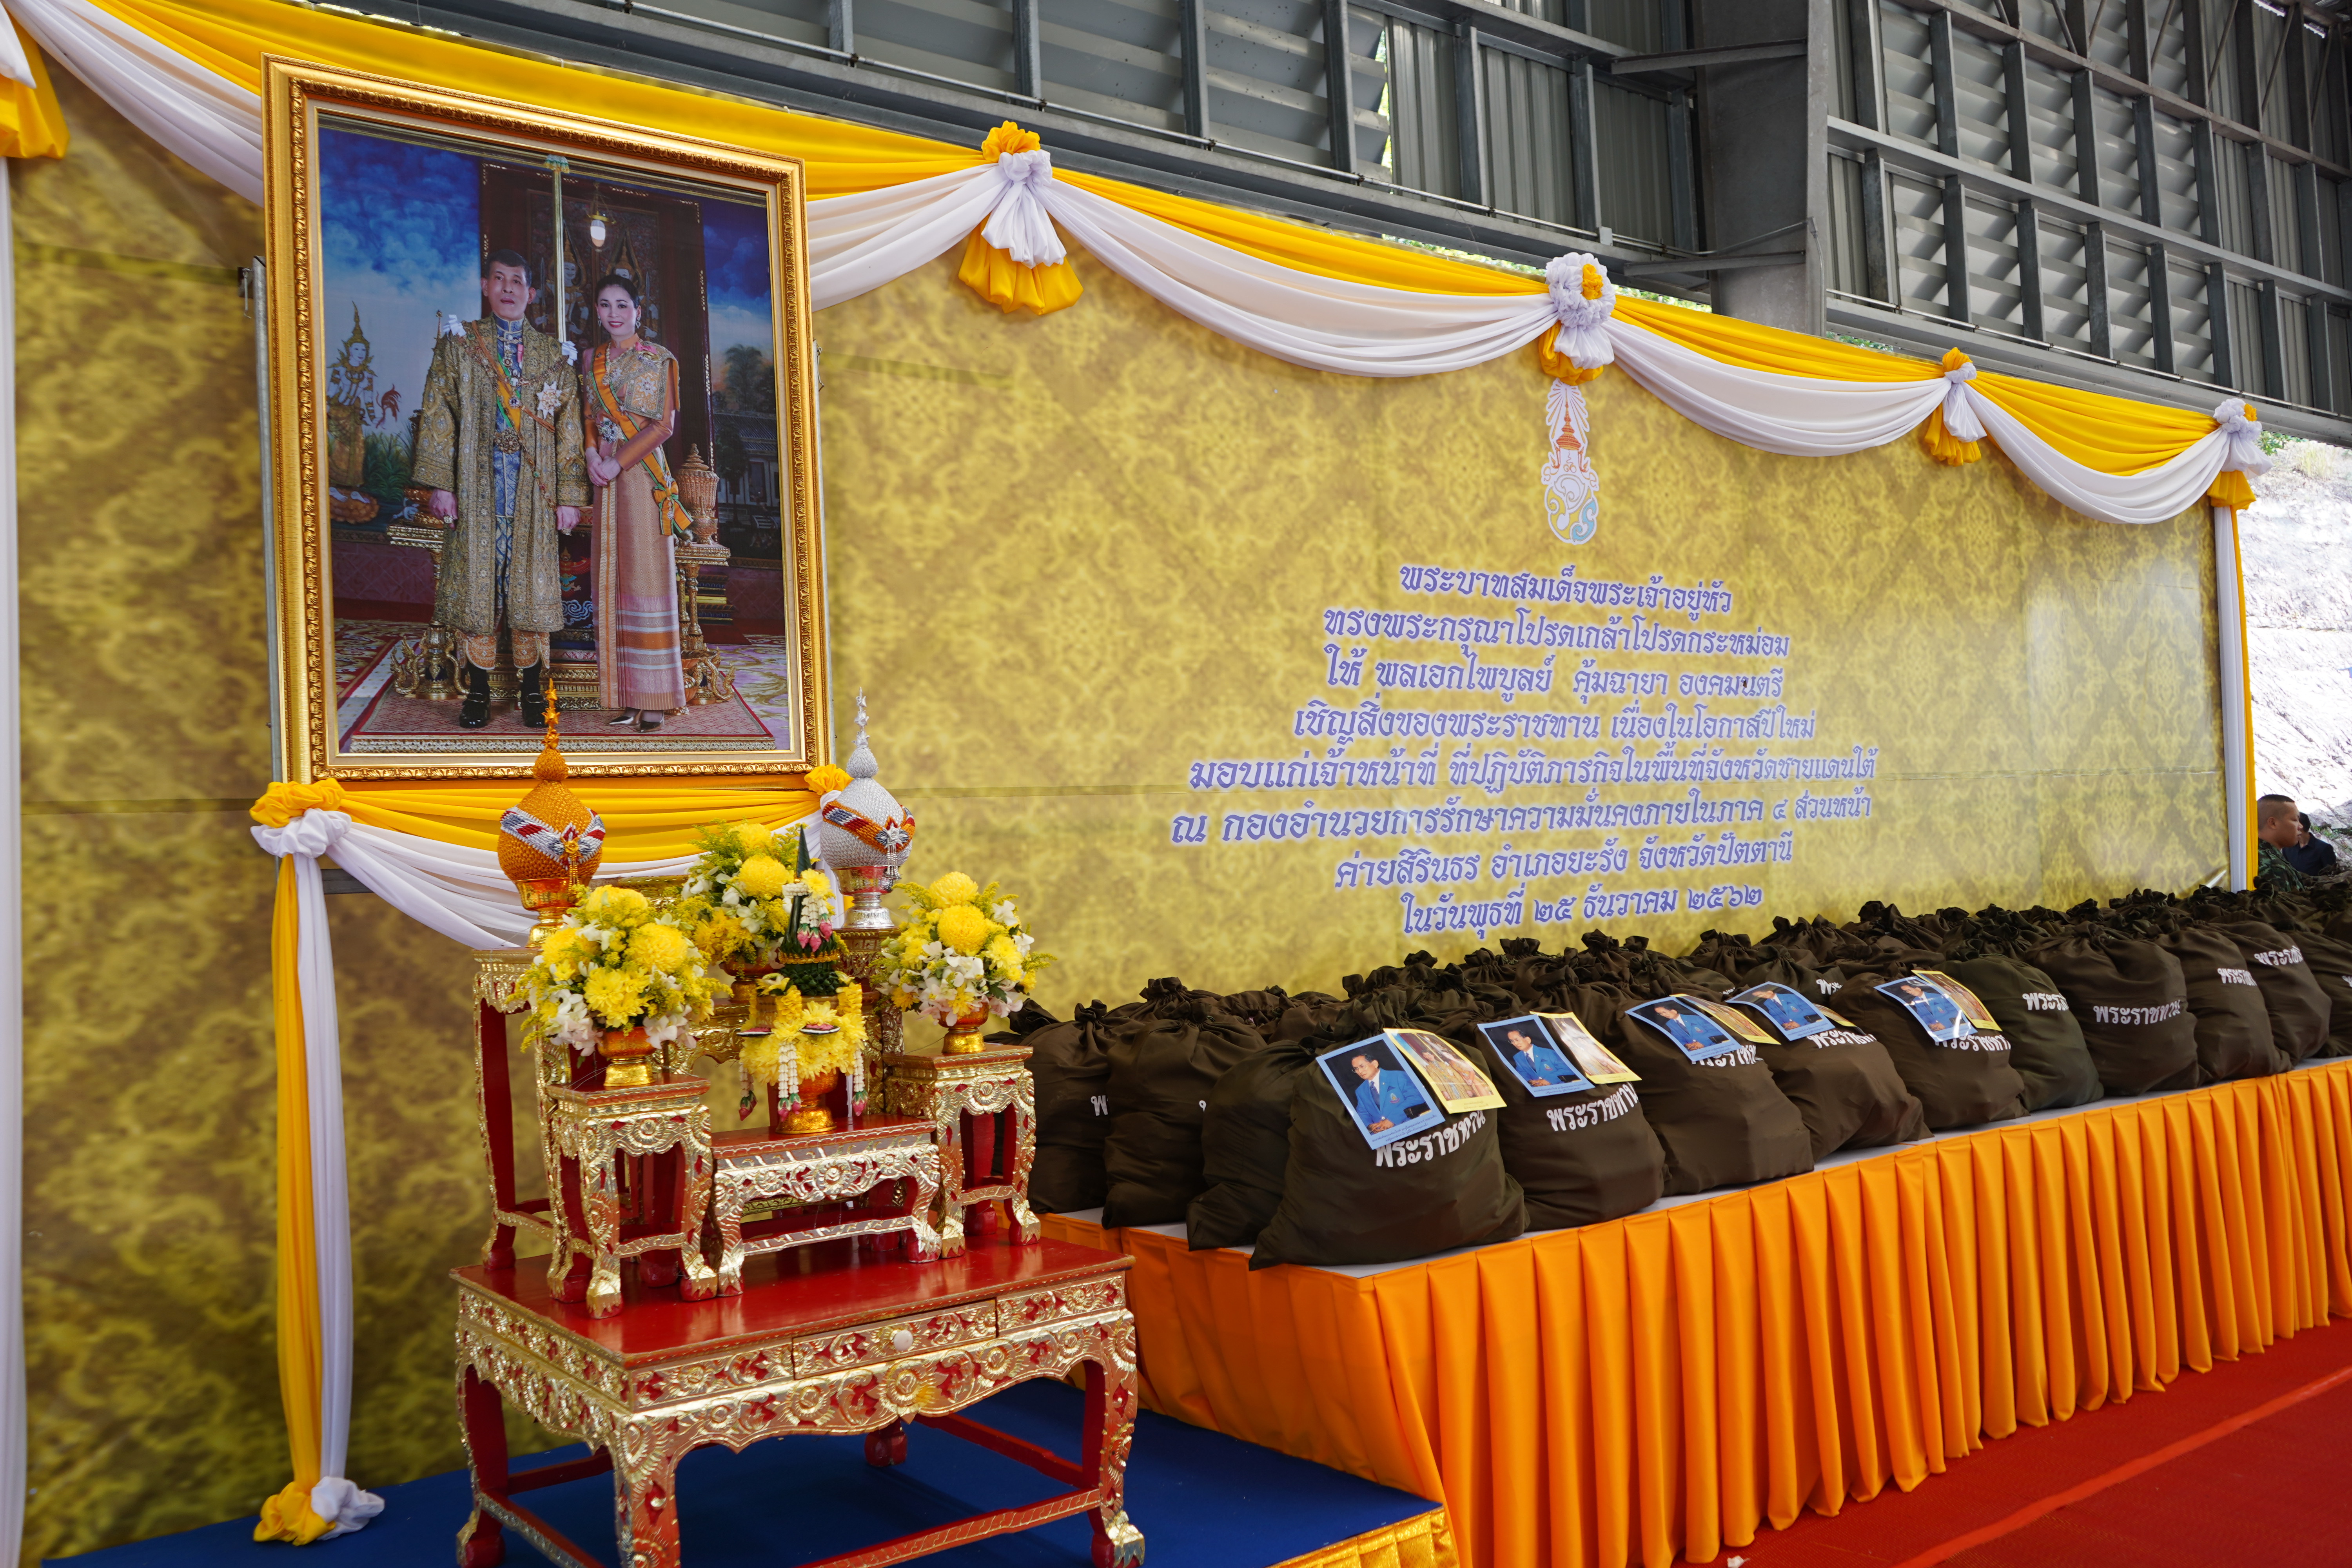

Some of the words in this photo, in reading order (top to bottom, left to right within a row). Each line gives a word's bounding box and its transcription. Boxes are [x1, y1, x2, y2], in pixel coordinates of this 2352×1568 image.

[1399, 565, 1732, 621] พระบาทสมเด็จพระเจ้าอยู่หัว
[1323, 607, 1790, 657] ทรงพระกรุณาโปรดเกล้าโปรดกระหม่อม
[1323, 643, 1368, 686] ให้
[1375, 652, 1556, 702] พลเอกไพบูลย์
[1573, 659, 1669, 704] คุ้มฉายา
[1679, 668, 1784, 697] องคมนตรี
[1294, 692, 1600, 745] เชิญสิ่งของพระราชทาน
[1611, 699, 1815, 739] เนื่องในโอกาสปีใหม่
[1189, 742, 1439, 789] มอบแก่เจ้าหน้าที่
[1449, 741, 1879, 794] ที่ปฏิบัติภารกิจในพื้นที่จังหวัดชายแดนใต้
[1171, 815, 1208, 843] ณ
[1221, 788, 1764, 841] กองอำนวยการรักษาความมั่นคงภายในภาค
[1773, 799, 1789, 820] ๔
[1795, 786, 1871, 819] ส่วนหน้า
[1335, 848, 1481, 887] ค่ายสิรินธร
[1491, 837, 1628, 879] อำเภอยะรัง
[1639, 830, 1793, 870] จังหวัดปัตตานี
[1400, 882, 1526, 940] ในวันพุธที่
[1533, 897, 1577, 923] ๒๕
[1583, 883, 1679, 919] ธันวาคม
[1687, 884, 1762, 910] ๒๕๖๒
[2093, 999, 2181, 1025] พระราชทาน
